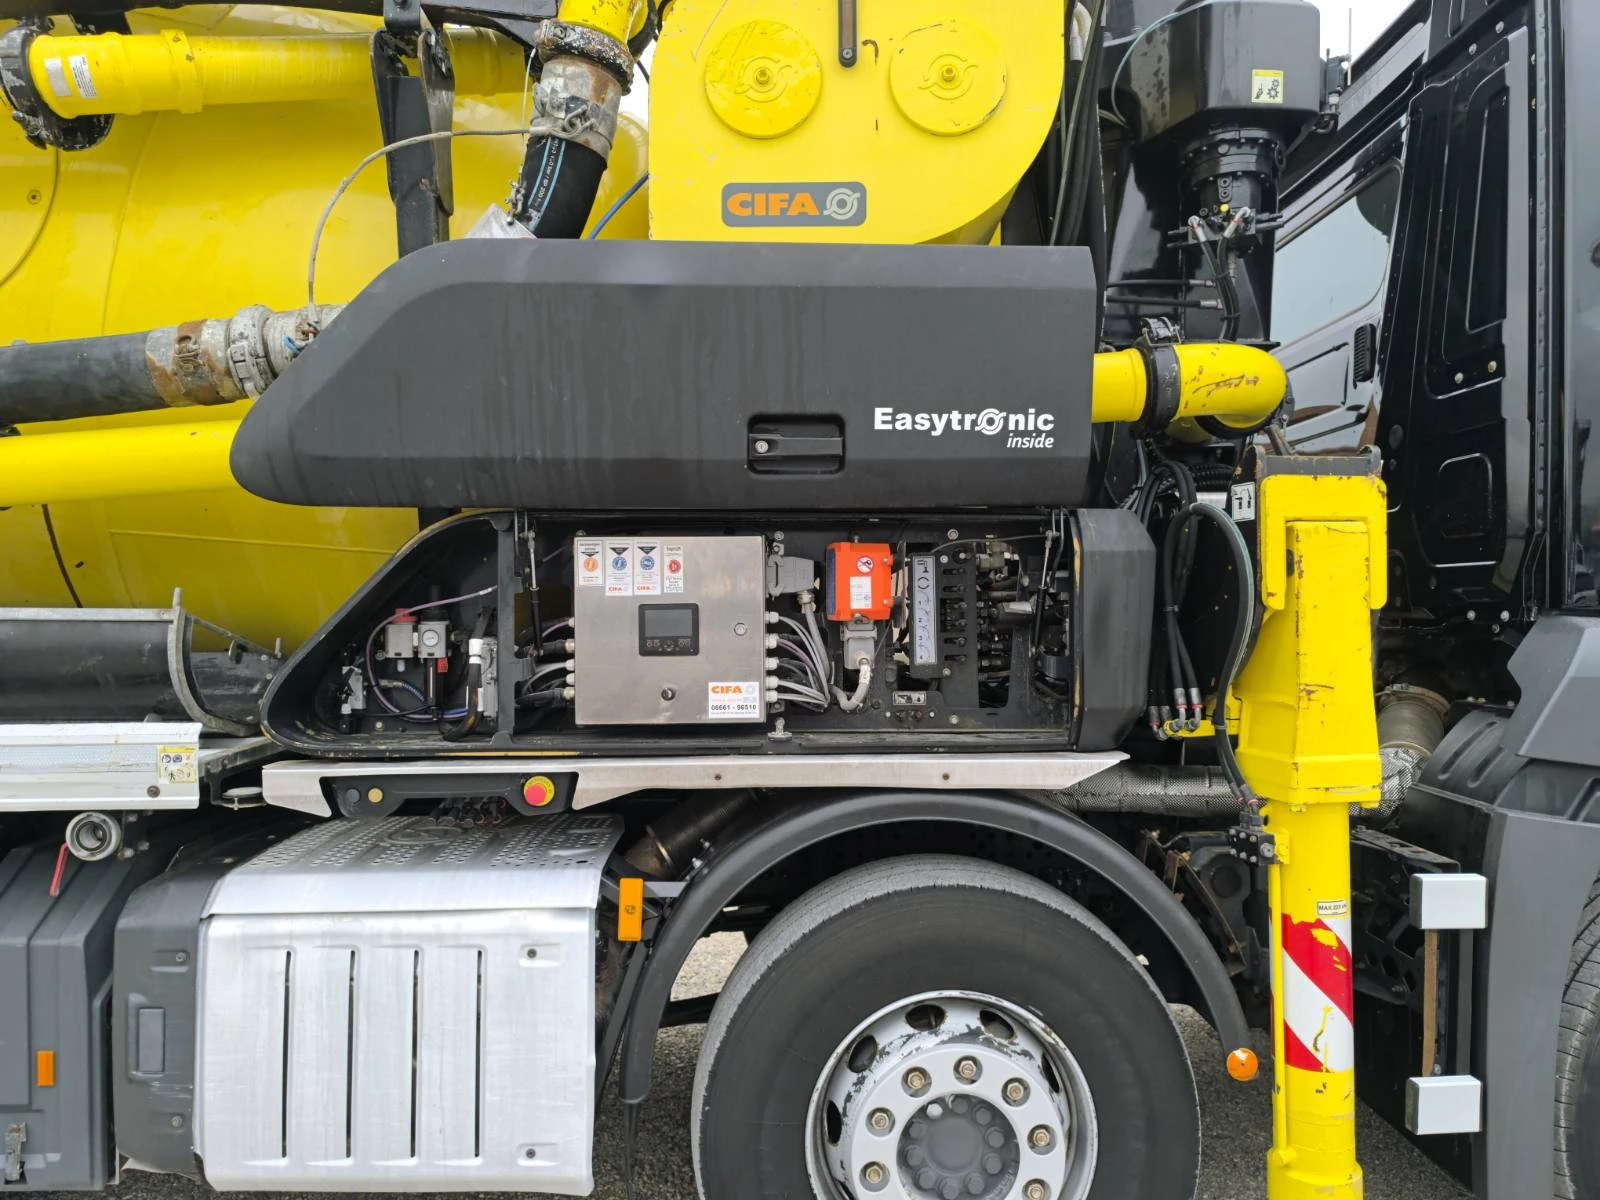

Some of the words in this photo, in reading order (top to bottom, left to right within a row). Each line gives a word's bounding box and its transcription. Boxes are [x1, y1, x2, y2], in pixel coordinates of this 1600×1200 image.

[726, 192, 820, 216] CIFA
[874, 407, 1055, 436] Easytronic
[1006, 433, 1054, 449] inside
[711, 685, 743, 694] CIFA
